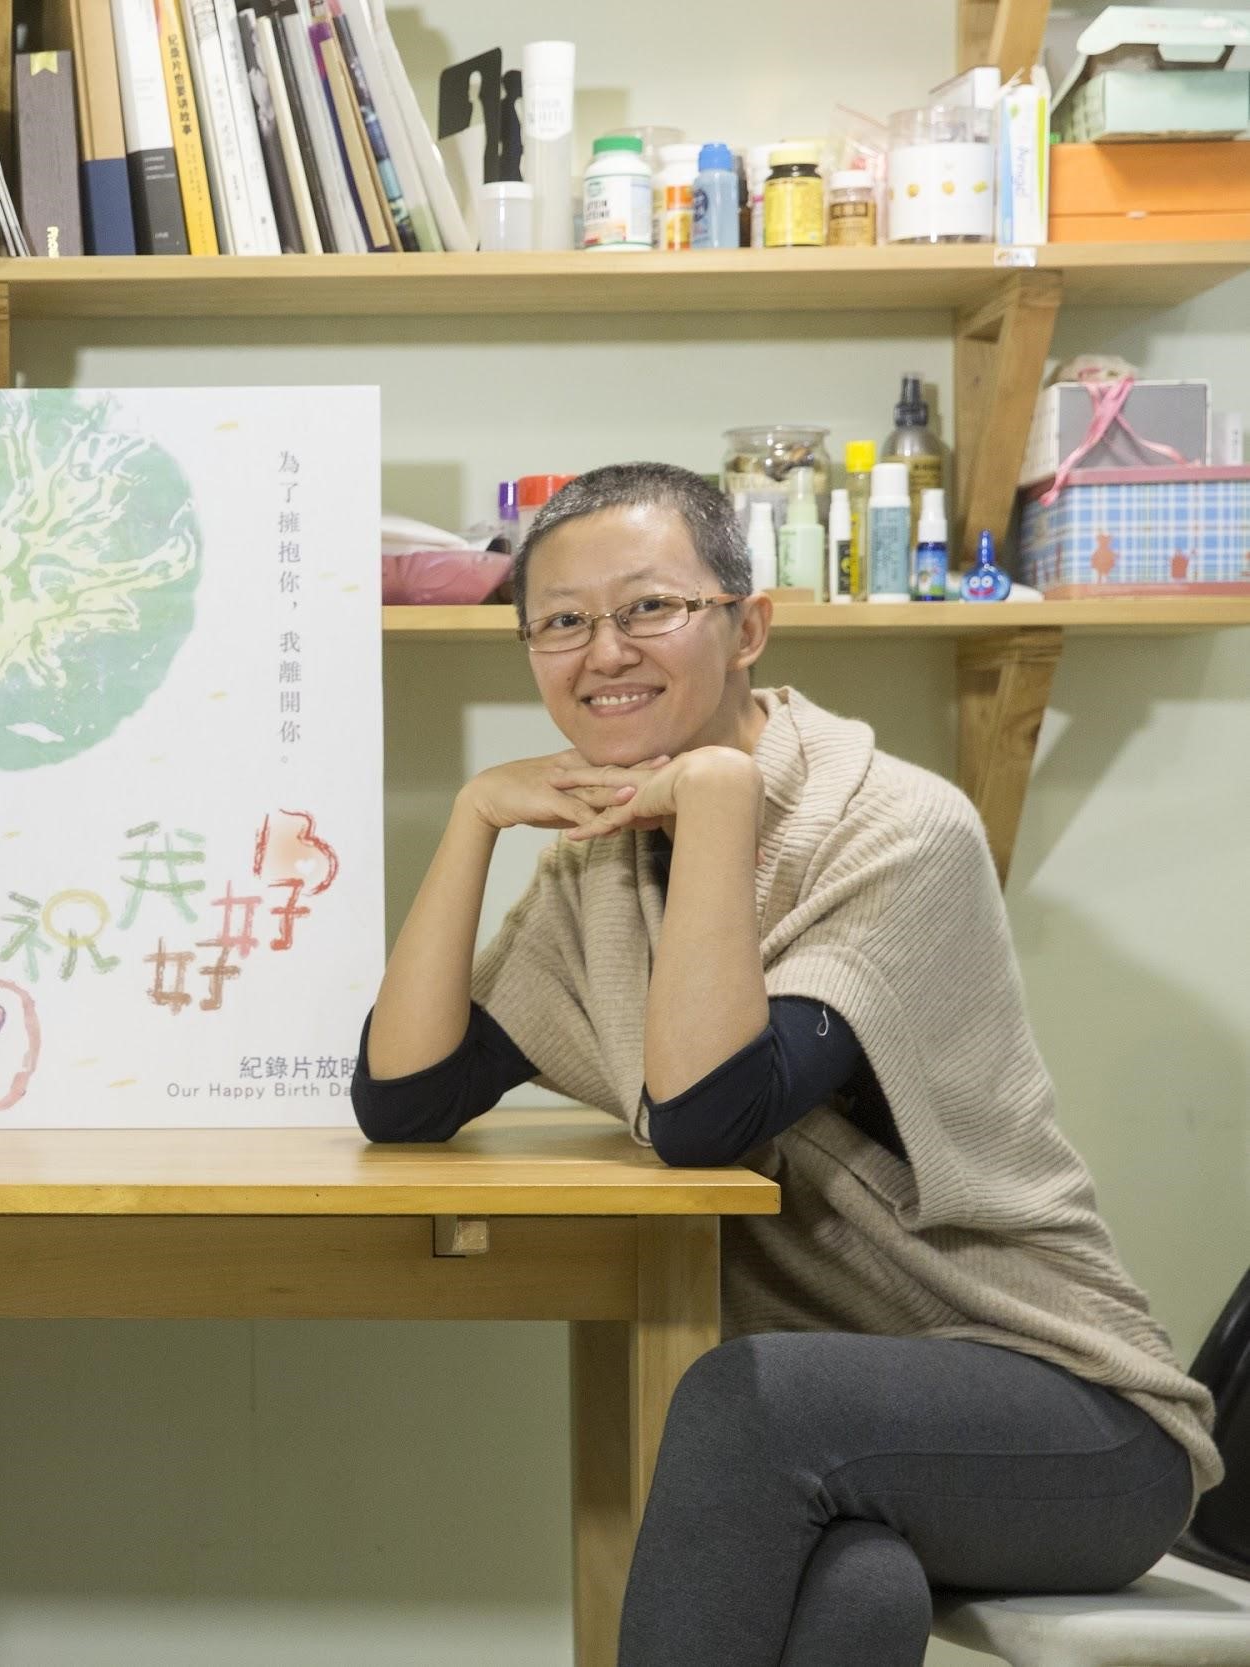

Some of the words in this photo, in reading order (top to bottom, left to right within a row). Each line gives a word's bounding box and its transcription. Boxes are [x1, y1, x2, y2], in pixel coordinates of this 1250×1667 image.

[278, 450, 301, 764] 為了擁抱你，我離開你。
[166, 1082, 200, 1097] Our
[209, 1082, 265, 1099] Happy
[274, 1082, 320, 1097] Birth
[329, 1082, 352, 1097] Da
